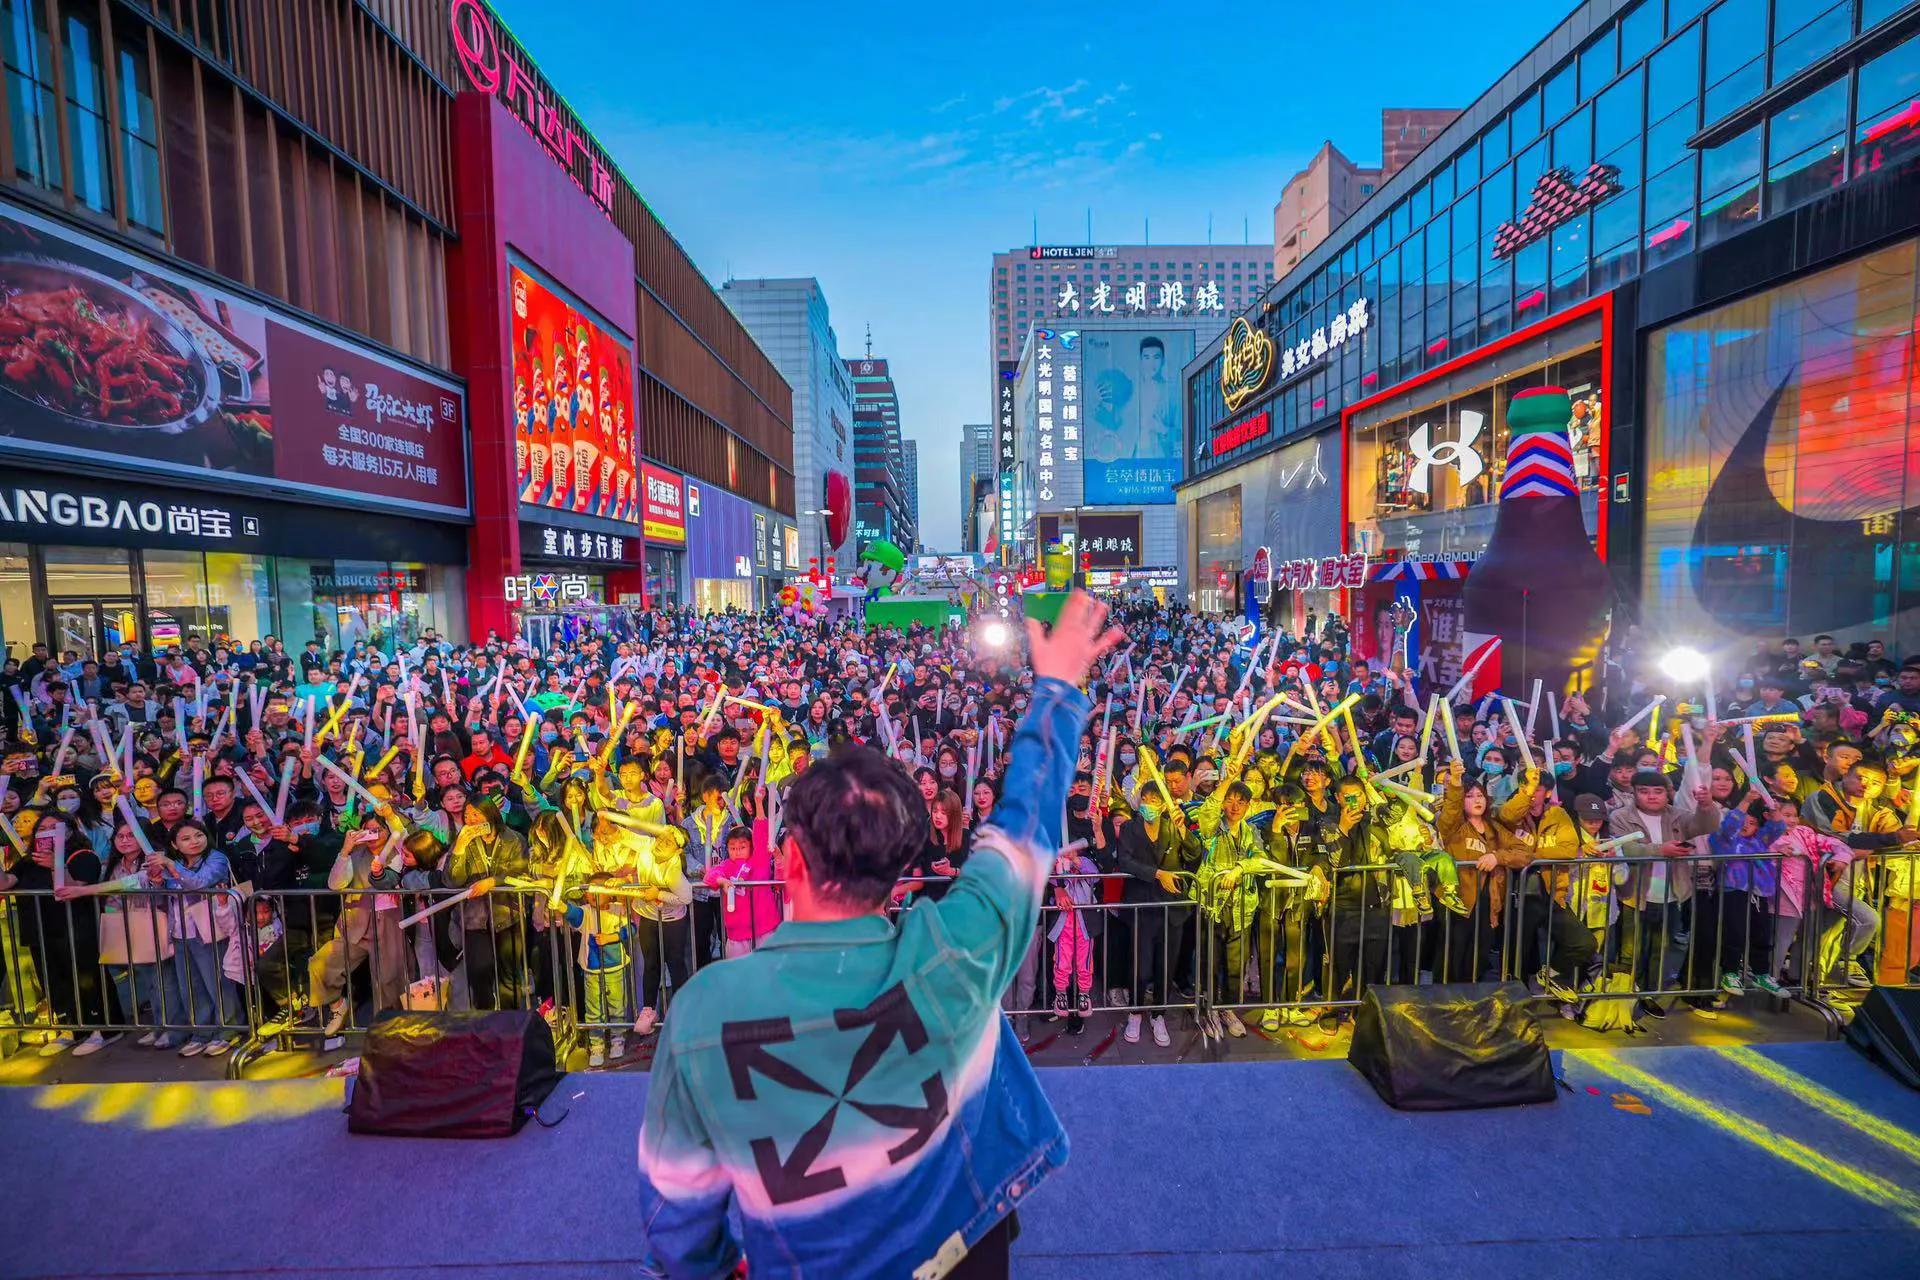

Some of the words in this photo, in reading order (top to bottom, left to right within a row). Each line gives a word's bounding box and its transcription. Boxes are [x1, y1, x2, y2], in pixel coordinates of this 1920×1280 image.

[1043, 247, 1074, 257] HOTEL
[1076, 247, 1094, 257] JEN
[1058, 280, 1225, 313] 大光明眼镜
[442, 401, 455, 419] 3F
[1037, 344, 1054, 502] 大光明国际名品中心
[166, 504, 233, 538] 尚宝
[543, 528, 623, 560] 室内步行街
[310, 574, 378, 587] STARBUCKS
[381, 575, 418, 588] COFFEE
[1279, 560, 1317, 591] 大汽水
